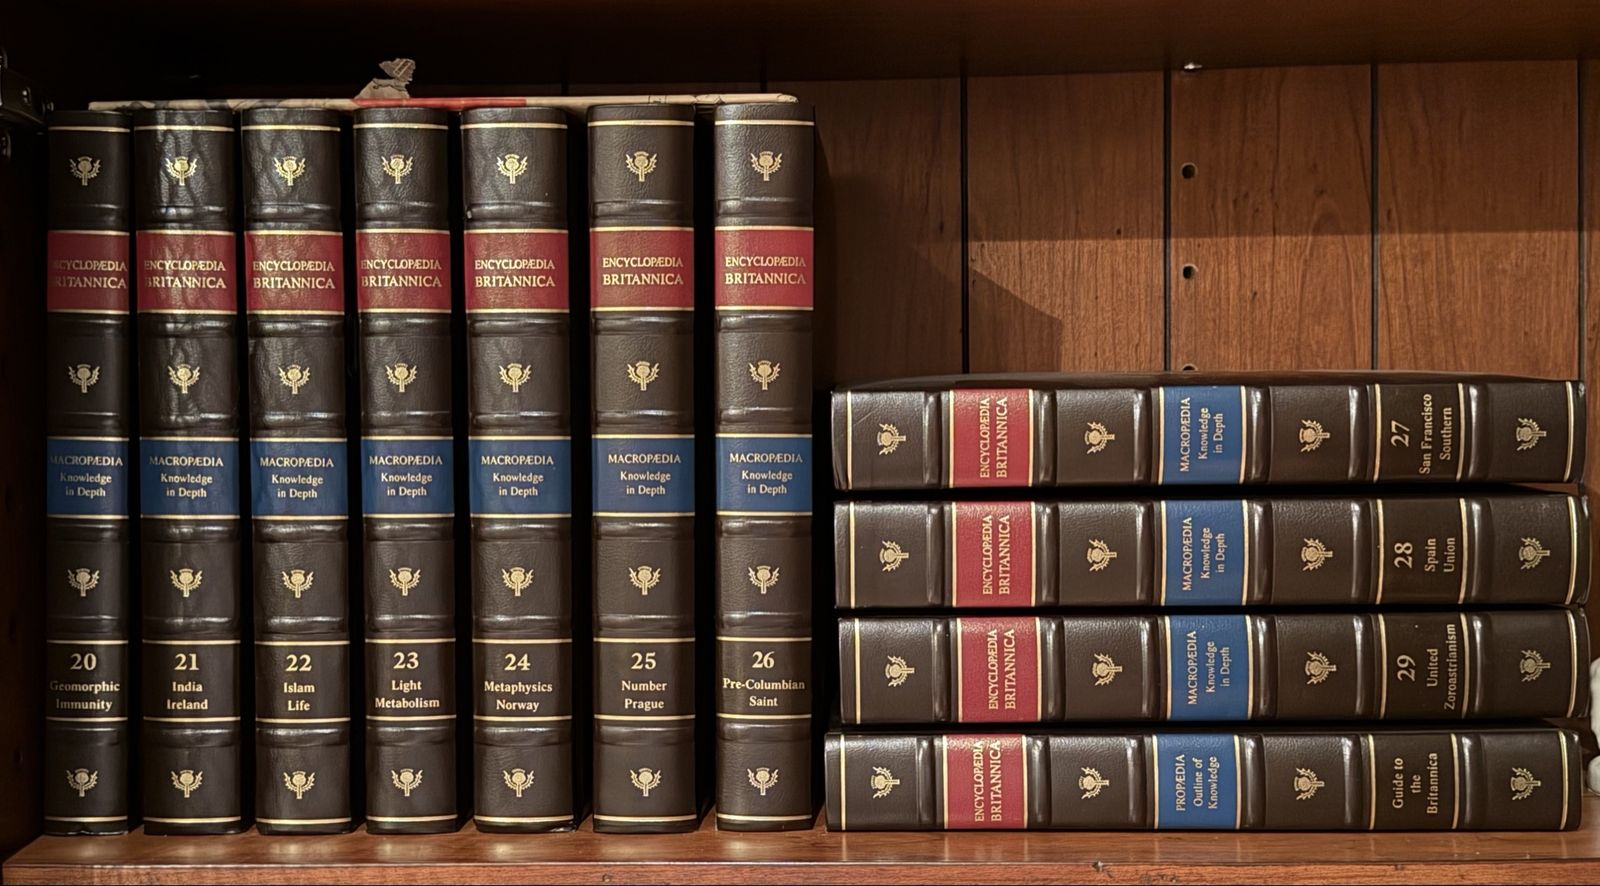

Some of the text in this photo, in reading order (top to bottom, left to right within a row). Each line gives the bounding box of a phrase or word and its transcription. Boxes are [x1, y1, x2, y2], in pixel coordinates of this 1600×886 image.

[253, 260, 336, 272] ENCYCLOPÆDIA
[361, 259, 442, 270] ENCYCLOPÆDIA
[474, 259, 556, 271] ENCYCLOPÆDIA
[602, 257, 684, 268] ENCYCLOPÆDIA
[725, 256, 807, 268] ENCYCLOPÆDIA
[51, 276, 127, 289] RITANNICA
[253, 277, 336, 289] BRITANNICA
[361, 275, 442, 288] BRITANNICA
[475, 275, 556, 288] BRITANNICA
[602, 273, 684, 286] BRITANNICA
[725, 272, 807, 285] BRITANNICA
[979, 397, 990, 478] ENCYCLOPÆDIA
[996, 397, 1008, 478] BRITANNICA
[1180, 397, 1191, 472] MACROPÆDIA
[1198, 408, 1210, 460] Knowledge
[1213, 413, 1226, 453] in Depth
[1391, 420, 1410, 447] 27
[1419, 393, 1433, 474] San Francisco
[1439, 407, 1453, 461] Southern
[149, 456, 224, 467] MACROPÆDIA
[260, 457, 334, 468] MACROPÆDIA
[369, 455, 443, 466] MACROPÆDIA
[481, 455, 554, 466] MACROPÆDIA
[608, 453, 681, 464] MACROPÆDIA
[729, 453, 803, 464] MACROPÆDIA
[60, 472, 112, 485] Knowledge
[160, 473, 213, 486] Knowledge
[272, 474, 324, 486] Knowledge
[381, 472, 432, 485] Knowledge
[493, 472, 544, 485] Knowledge
[620, 471, 671, 483] Knowledge
[741, 470, 793, 482] Knowledge
[65, 486, 106, 499] in Depth
[166, 487, 207, 500] in Depth
[277, 488, 318, 500] in Depth
[387, 486, 427, 499] in Depth
[499, 486, 538, 498] in Depth
[626, 485, 666, 497] in Depth
[747, 484, 787, 496] in Depth
[982, 514, 993, 595] ENCYCLOPÆDIA
[998, 514, 1010, 595] BRITANNICA
[1182, 517, 1193, 591] MACROPÆDIA
[1200, 527, 1213, 579] Knowledge
[1215, 533, 1227, 573] in Depth
[1394, 542, 1413, 569] 28
[1424, 538, 1439, 572] Spain
[1443, 537, 1456, 573] Union
[70, 652, 97, 671] 20
[174, 653, 199, 672] 21
[285, 654, 312, 672] 22
[392, 651, 420, 670] 23
[504, 653, 531, 671] 24
[631, 652, 657, 670] 25
[752, 651, 775, 669] 26
[1205, 641, 1217, 693] Knowledge
[1220, 647, 1232, 687] in Depth
[1444, 623, 1458, 710] Zoroastrianism
[987, 629, 999, 710] ENCYCLOPÆDIA
[1003, 629, 1016, 710] BRITANNICA
[1187, 631, 1197, 705] MACROPÆDIA
[1396, 655, 1416, 682] 29
[1426, 648, 1439, 687] United
[49, 680, 121, 694] Geomorphic
[172, 681, 203, 693] India
[283, 682, 315, 693] Islam
[391, 679, 422, 693] Light
[484, 679, 553, 693] Metaphysics
[621, 679, 668, 692] Number
[722, 677, 805, 690] Pre-Columbian
[56, 698, 113, 712] Immunity
[166, 698, 208, 710] Ireland
[287, 699, 311, 712] Life
[375, 696, 440, 709] Metabolism
[496, 698, 540, 712] Norway
[624, 698, 665, 711] Prague
[749, 695, 778, 707] Saint
[973, 740, 985, 822] ENCYCLOPÆDIA
[989, 740, 1002, 822] BRITANNICA
[1176, 754, 1186, 812] PROPÆDIA
[1192, 757, 1204, 807] Outline of
[1208, 756, 1220, 809] Knowledge
[1392, 757, 1404, 809] Guide to
[1410, 774, 1422, 794] the
[1426, 752, 1438, 814] Britannica
